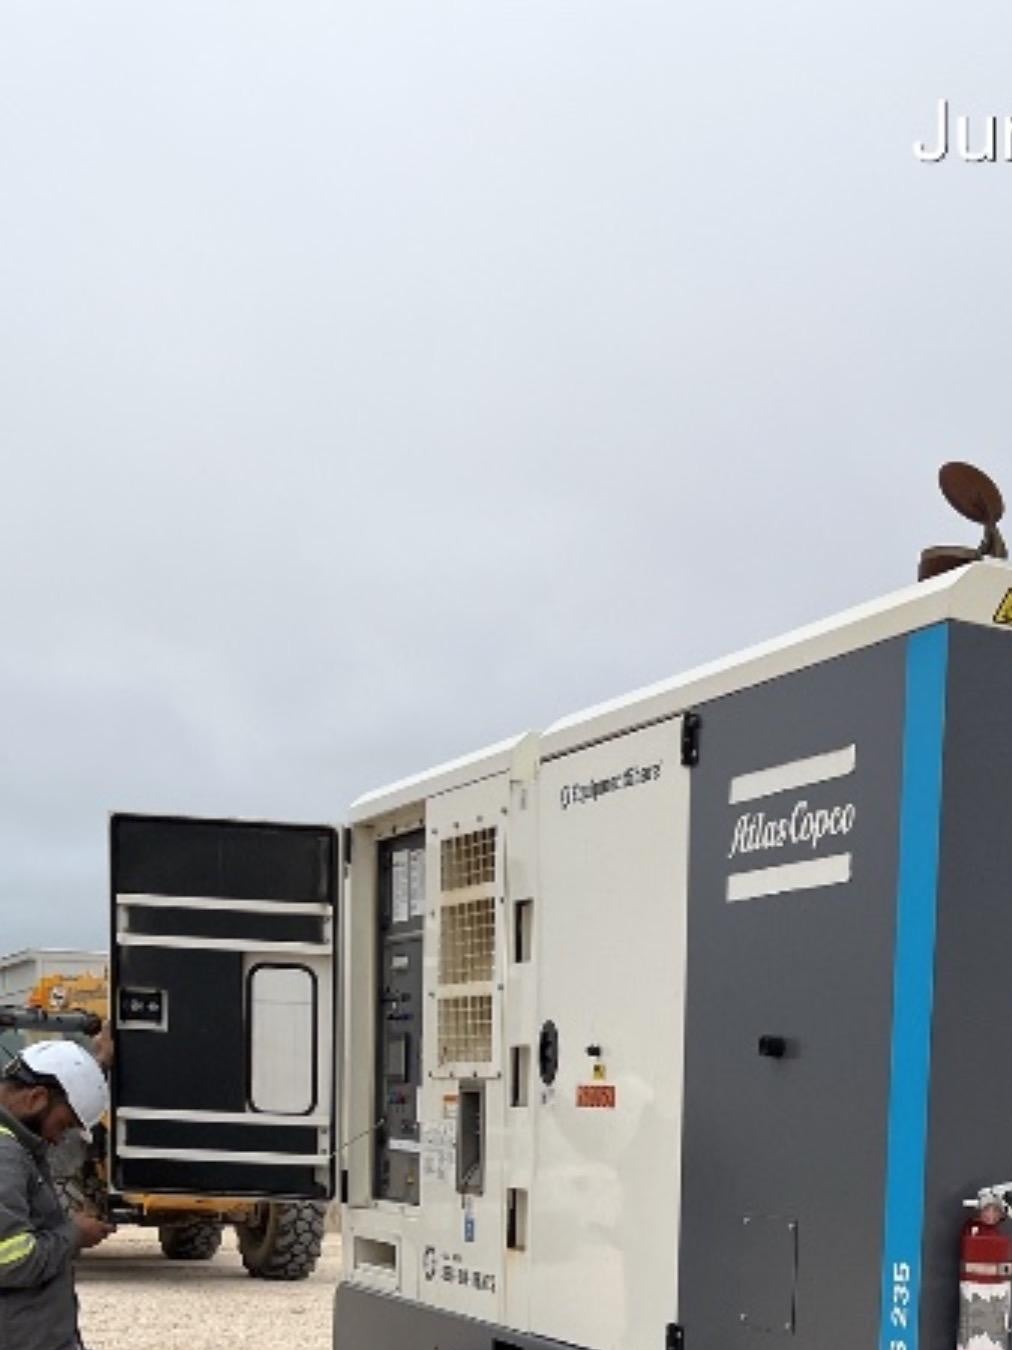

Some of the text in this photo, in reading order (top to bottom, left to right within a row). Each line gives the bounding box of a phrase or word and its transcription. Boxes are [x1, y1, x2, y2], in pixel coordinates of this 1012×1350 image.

[727, 800, 856, 859] Atlas Copco
[890, 1262, 910, 1328] 235
